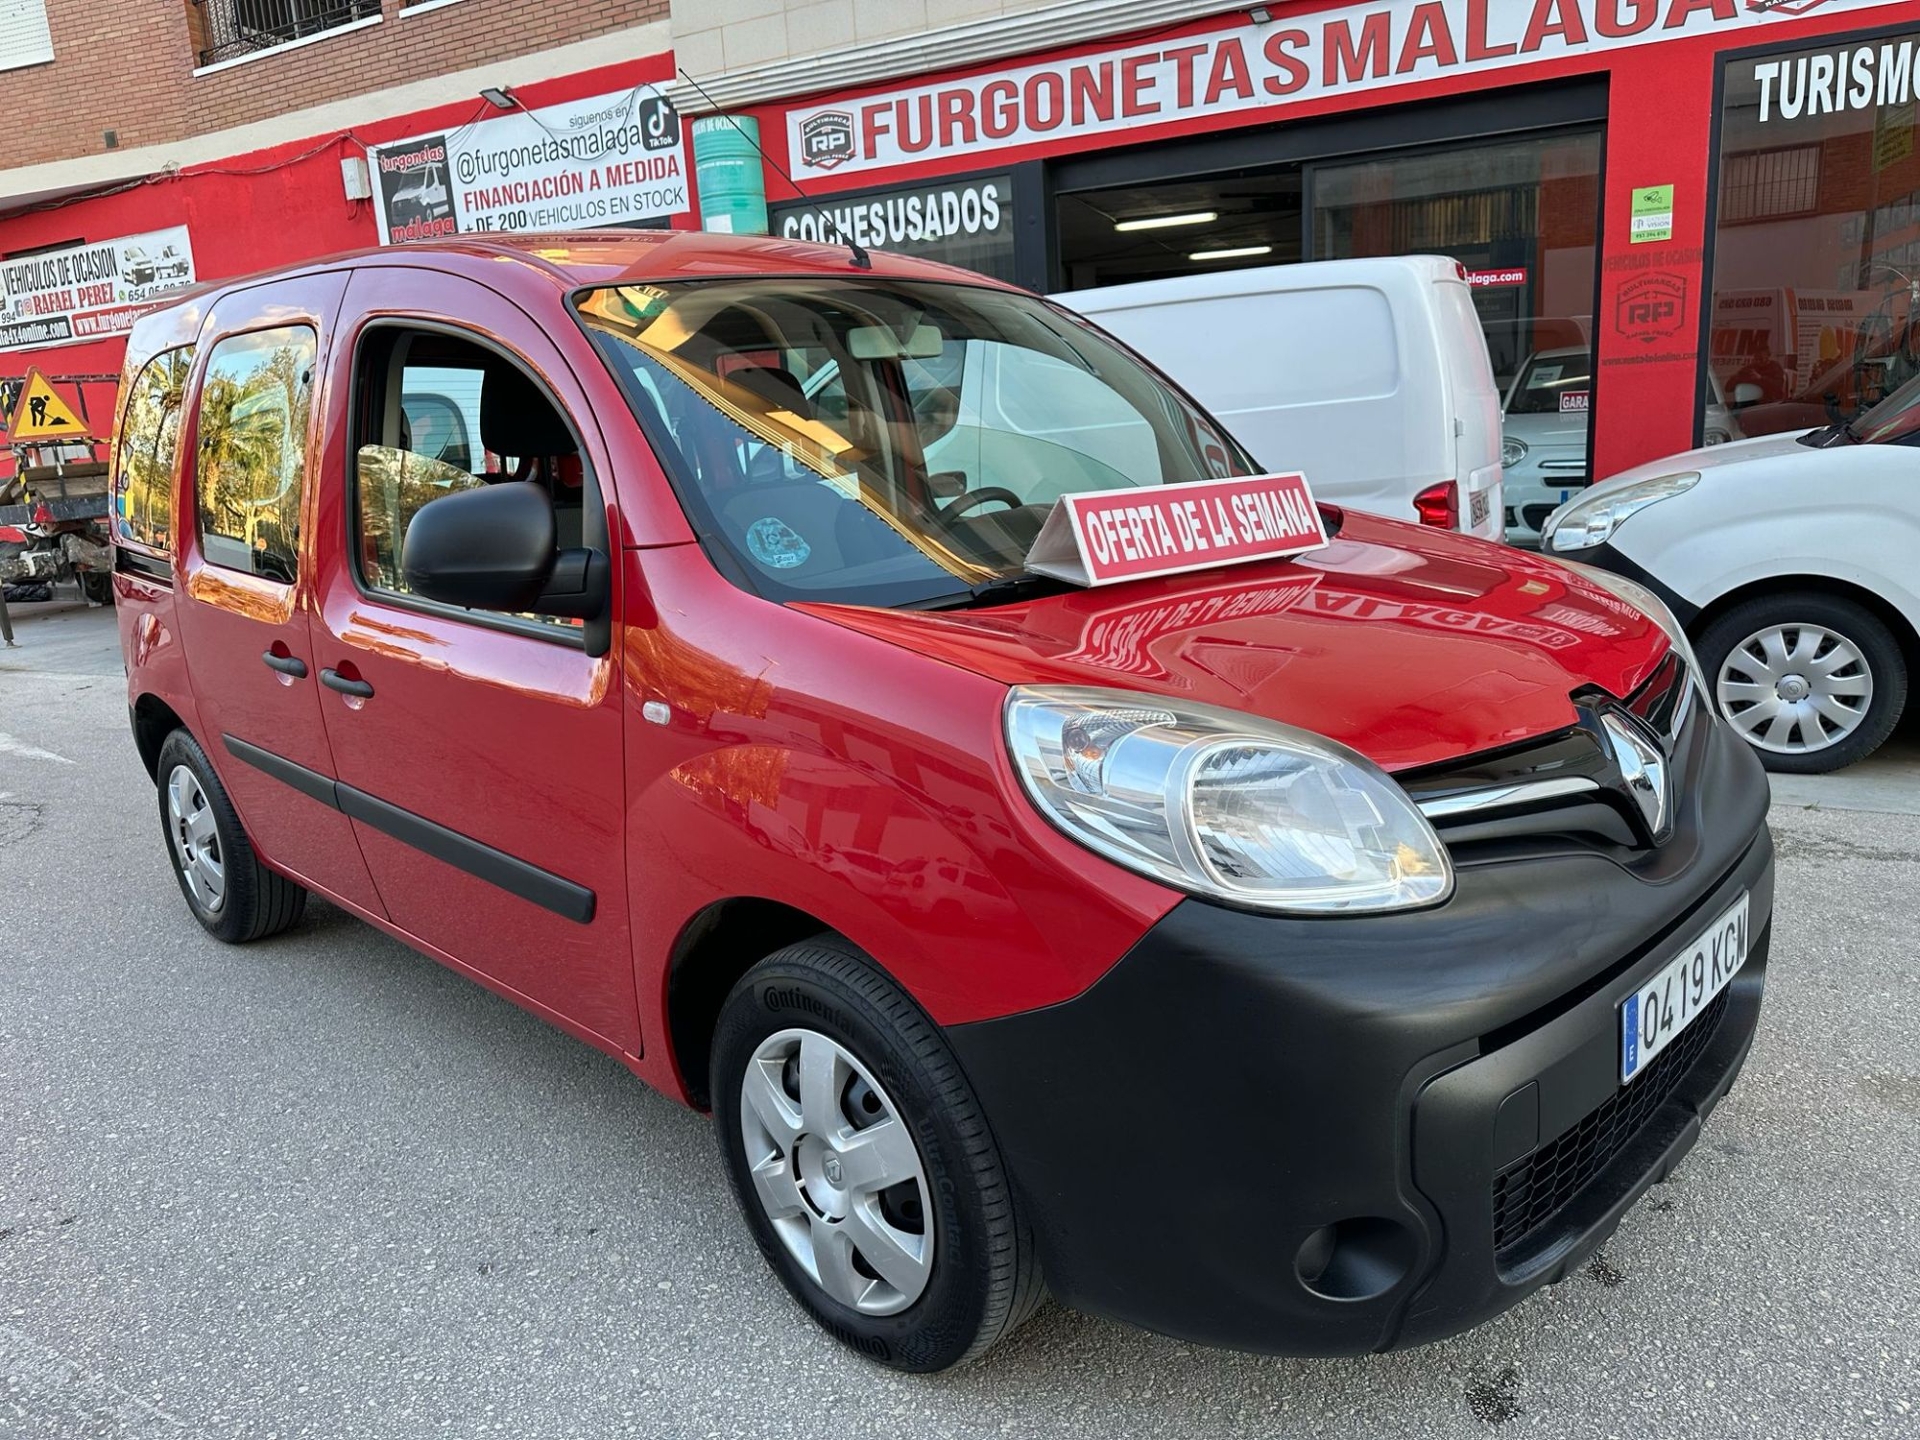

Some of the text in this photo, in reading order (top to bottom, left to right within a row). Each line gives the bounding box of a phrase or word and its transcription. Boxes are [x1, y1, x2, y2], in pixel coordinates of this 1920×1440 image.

[1754, 41, 1920, 122] TURISM
[568, 110, 613, 129] siguenos
[380, 144, 445, 173] furgonetas
[456, 124, 642, 185] @furgonetasmalaga
[649, 136, 673, 148] TikTok
[811, 132, 845, 153] RP
[464, 154, 680, 213] FINANCIACIÓN A MEDIDA
[476, 215, 493, 232] DE
[498, 210, 527, 231] 200
[529, 200, 606, 228] VEHICULOS
[610, 195, 629, 215] EN
[634, 186, 684, 209] STOCK
[390, 216, 455, 243] málaga
[2, 247, 118, 296] VEHICULOS DE OCASION
[32, 282, 116, 316] RAFAEL PEREZ
[128, 289, 146, 302] 654
[1628, 302, 1674, 325] RP
[1086, 488, 1317, 565] OFERTA DE LA SEMANA
[763, 985, 856, 1040] Continental
[1644, 951, 1704, 1050] 0419
[1628, 1045, 1634, 1061] E
